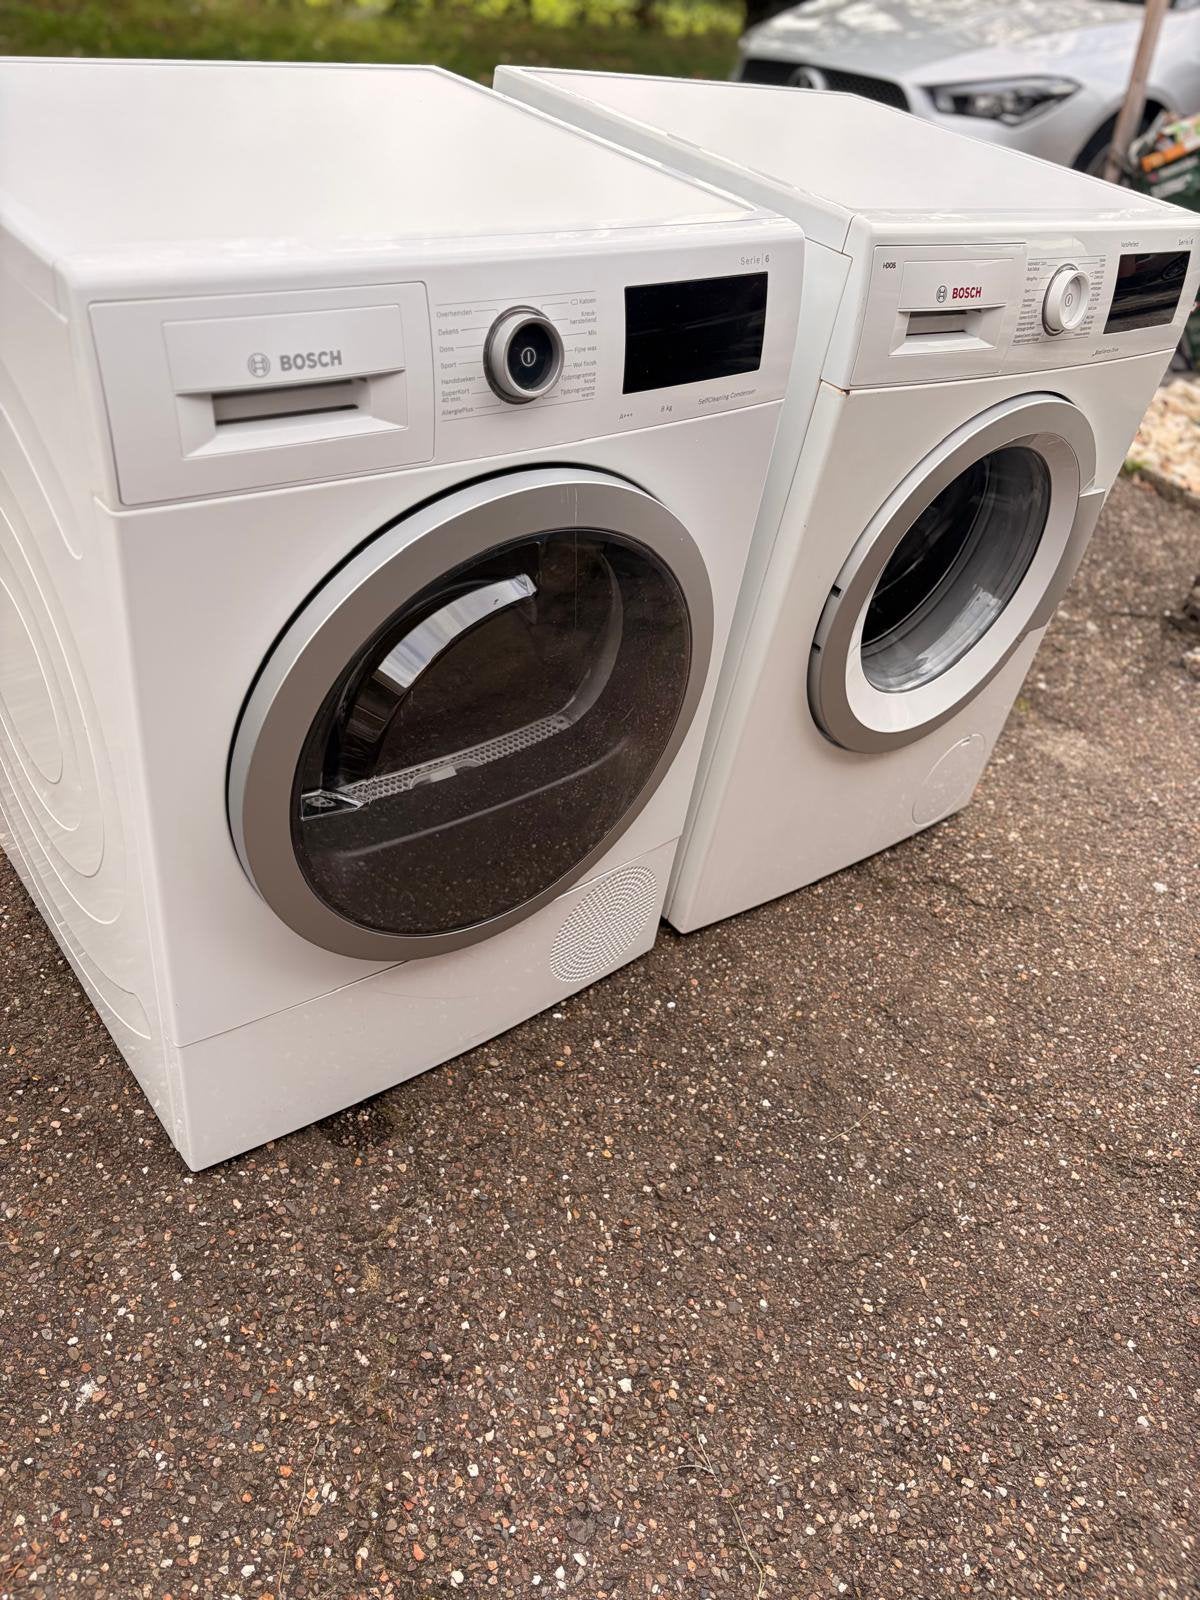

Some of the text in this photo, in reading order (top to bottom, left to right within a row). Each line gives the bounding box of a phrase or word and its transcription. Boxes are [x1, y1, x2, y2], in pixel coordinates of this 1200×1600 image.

[740, 254, 770, 266] Serie 6
[952, 286, 982, 299] BOSCH
[436, 309, 473, 319] Overhemden
[280, 350, 342, 371] BOSCH
[440, 362, 457, 370] Sport
[442, 388, 470, 397] SuperKort
[698, 388, 757, 405] SelfCleaning Condenser
[441, 406, 474, 416] AllergiePlus
[666, 405, 672, 413] kg
